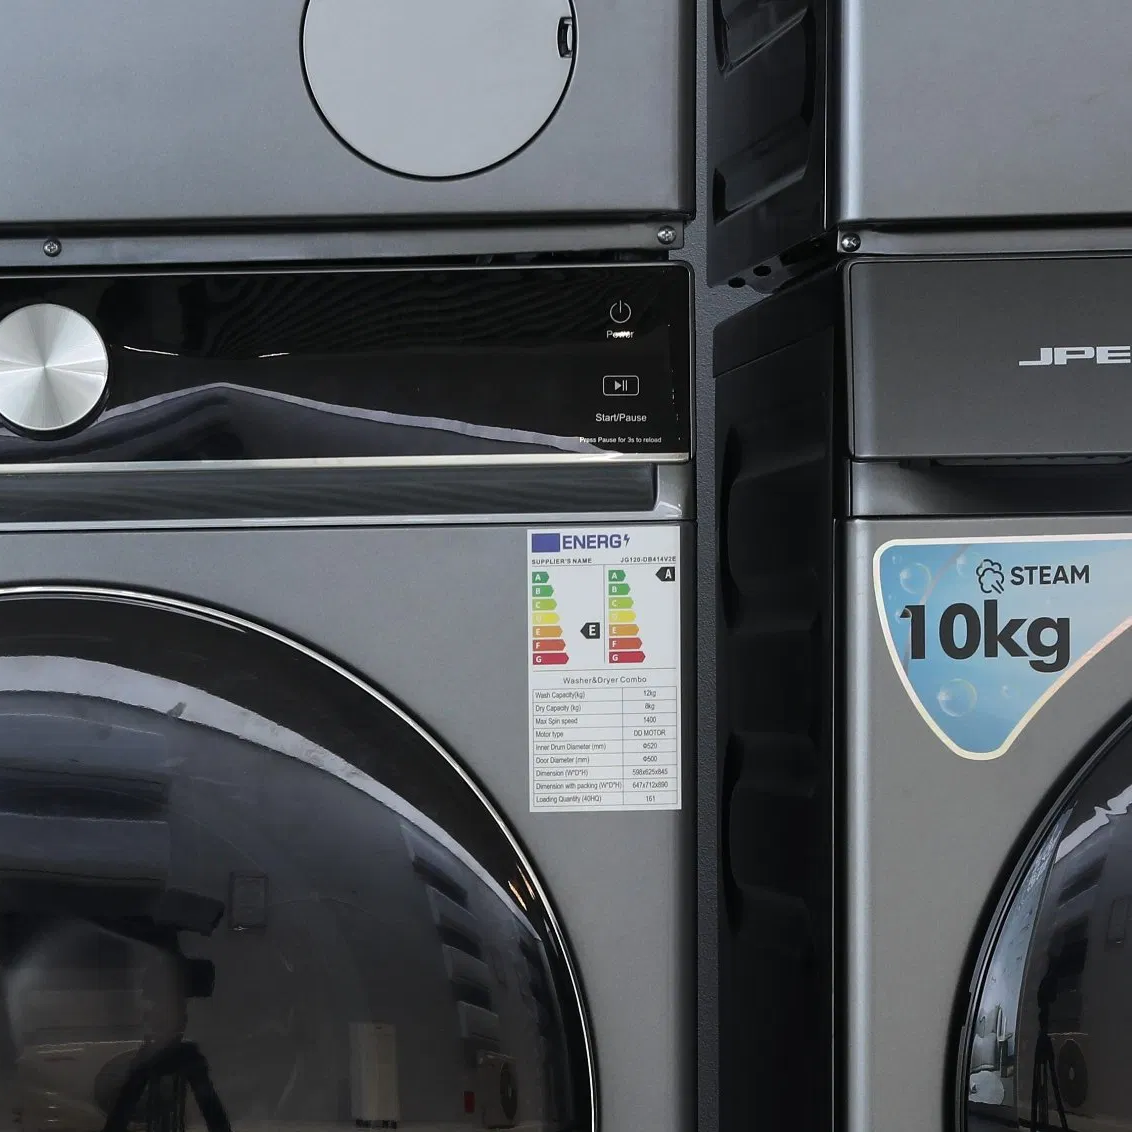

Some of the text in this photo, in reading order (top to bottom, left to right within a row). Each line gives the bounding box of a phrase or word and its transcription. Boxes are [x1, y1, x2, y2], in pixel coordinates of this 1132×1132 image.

[606, 330, 634, 338] Power
[1019, 346, 1131, 366] JPE
[596, 414, 647, 422] Start/Pause
[562, 534, 622, 550] ENERG
[665, 569, 672, 579] A
[1010, 564, 1090, 585] STEAM
[589, 625, 596, 636] E
[899, 600, 1071, 672] 10kg
[563, 676, 619, 684] Washer&Dryer
[644, 690, 656, 698] 12kg
[550, 756, 574, 764] Diameter
[576, 756, 590, 764] (mm)
[566, 782, 576, 790] with
[577, 782, 598, 790] packing
